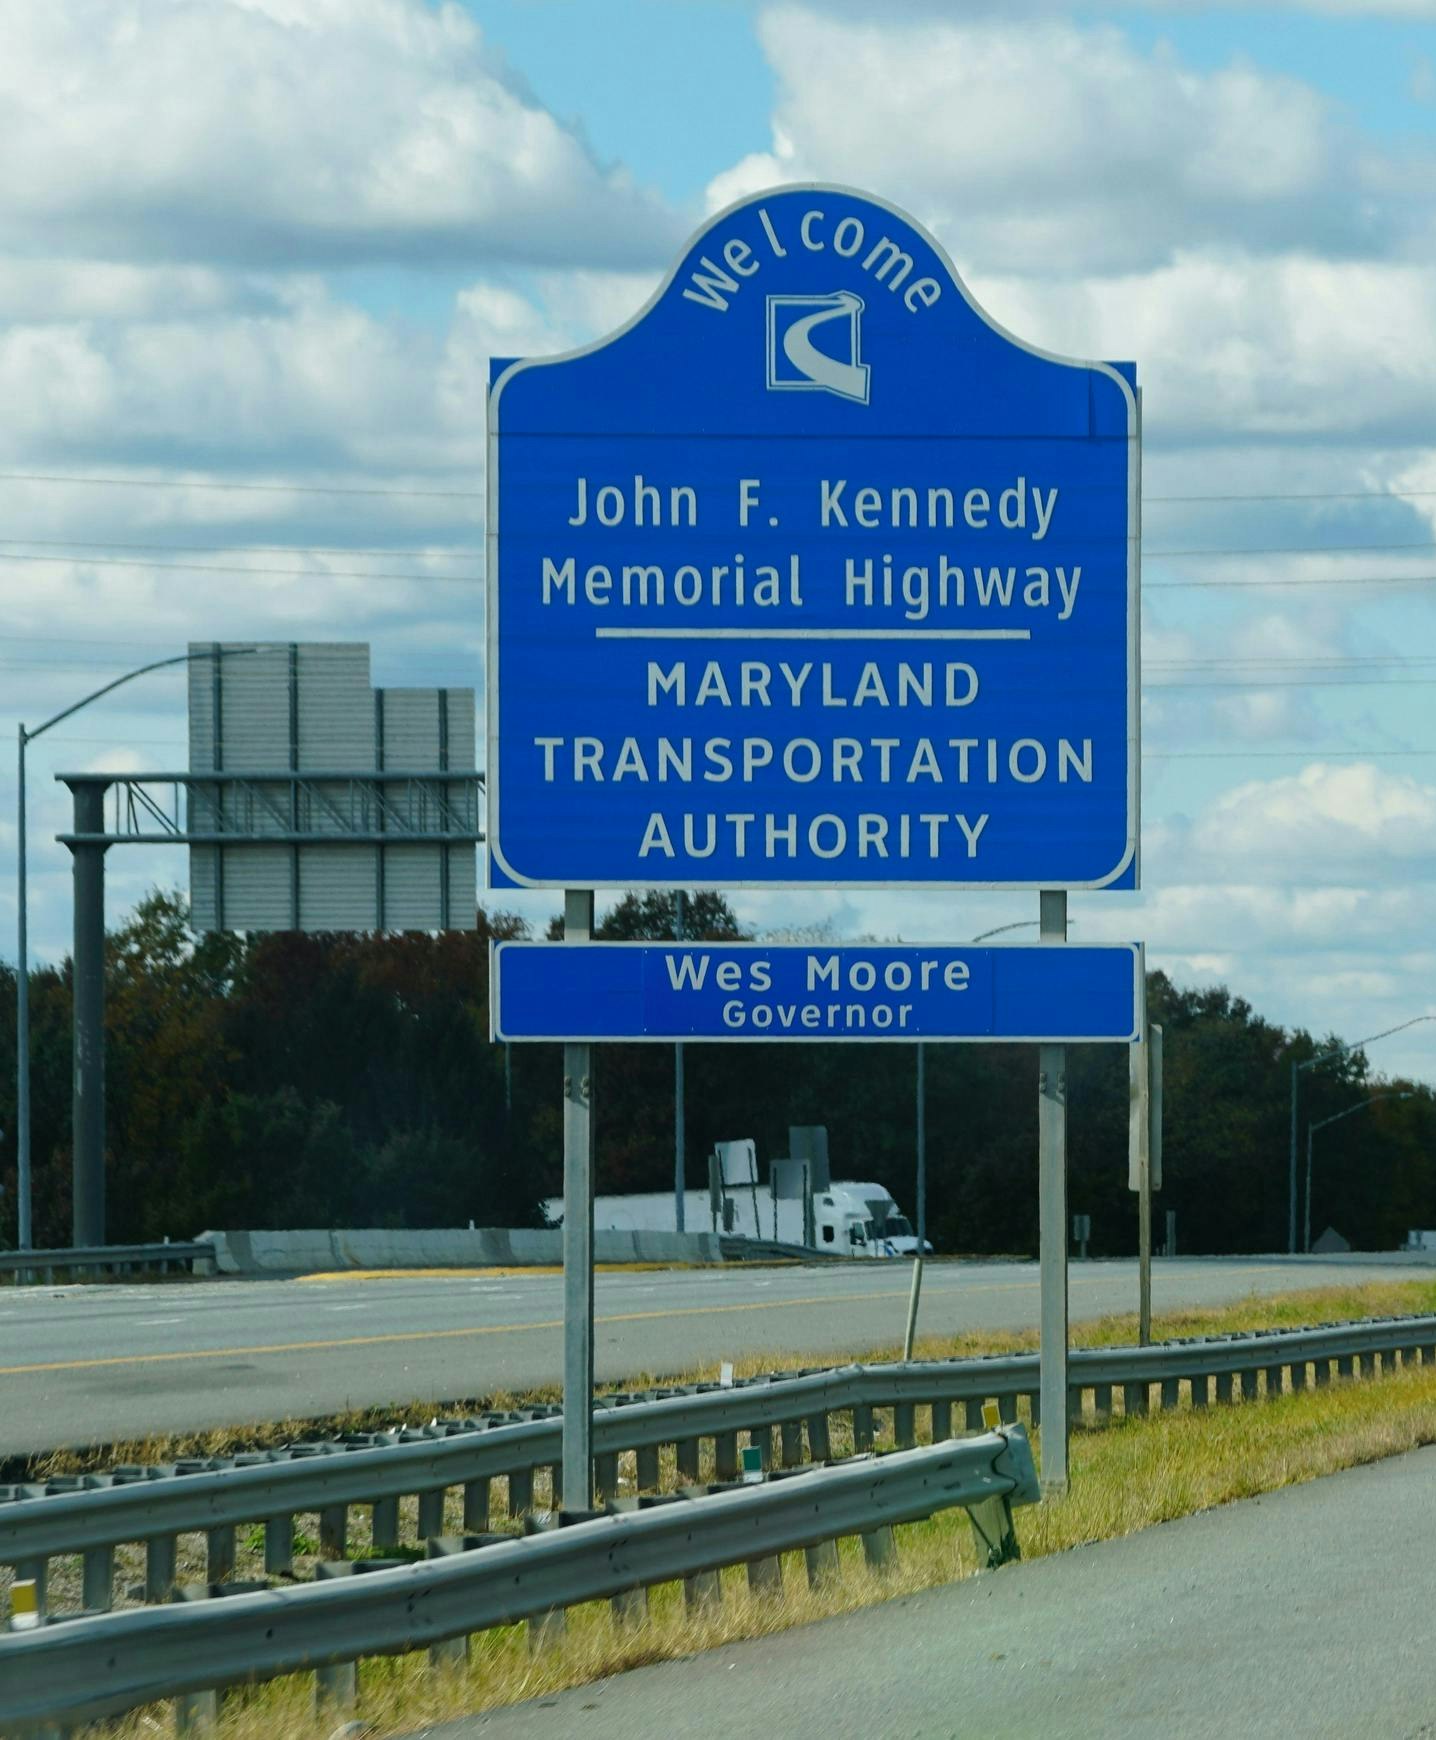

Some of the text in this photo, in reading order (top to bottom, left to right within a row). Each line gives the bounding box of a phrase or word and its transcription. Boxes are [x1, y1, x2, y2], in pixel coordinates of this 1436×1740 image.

[682, 208, 943, 314] Welcome
[568, 476, 1059, 540] John F. Kennedy
[542, 554, 1082, 620] Memorial Highway
[647, 661, 980, 707] MARYLAND
[534, 737, 1093, 783] TRANSPORTATION
[638, 812, 989, 859] AUTHORITY
[665, 955, 971, 992] Wes Moore
[722, 1000, 913, 1028] Governor
